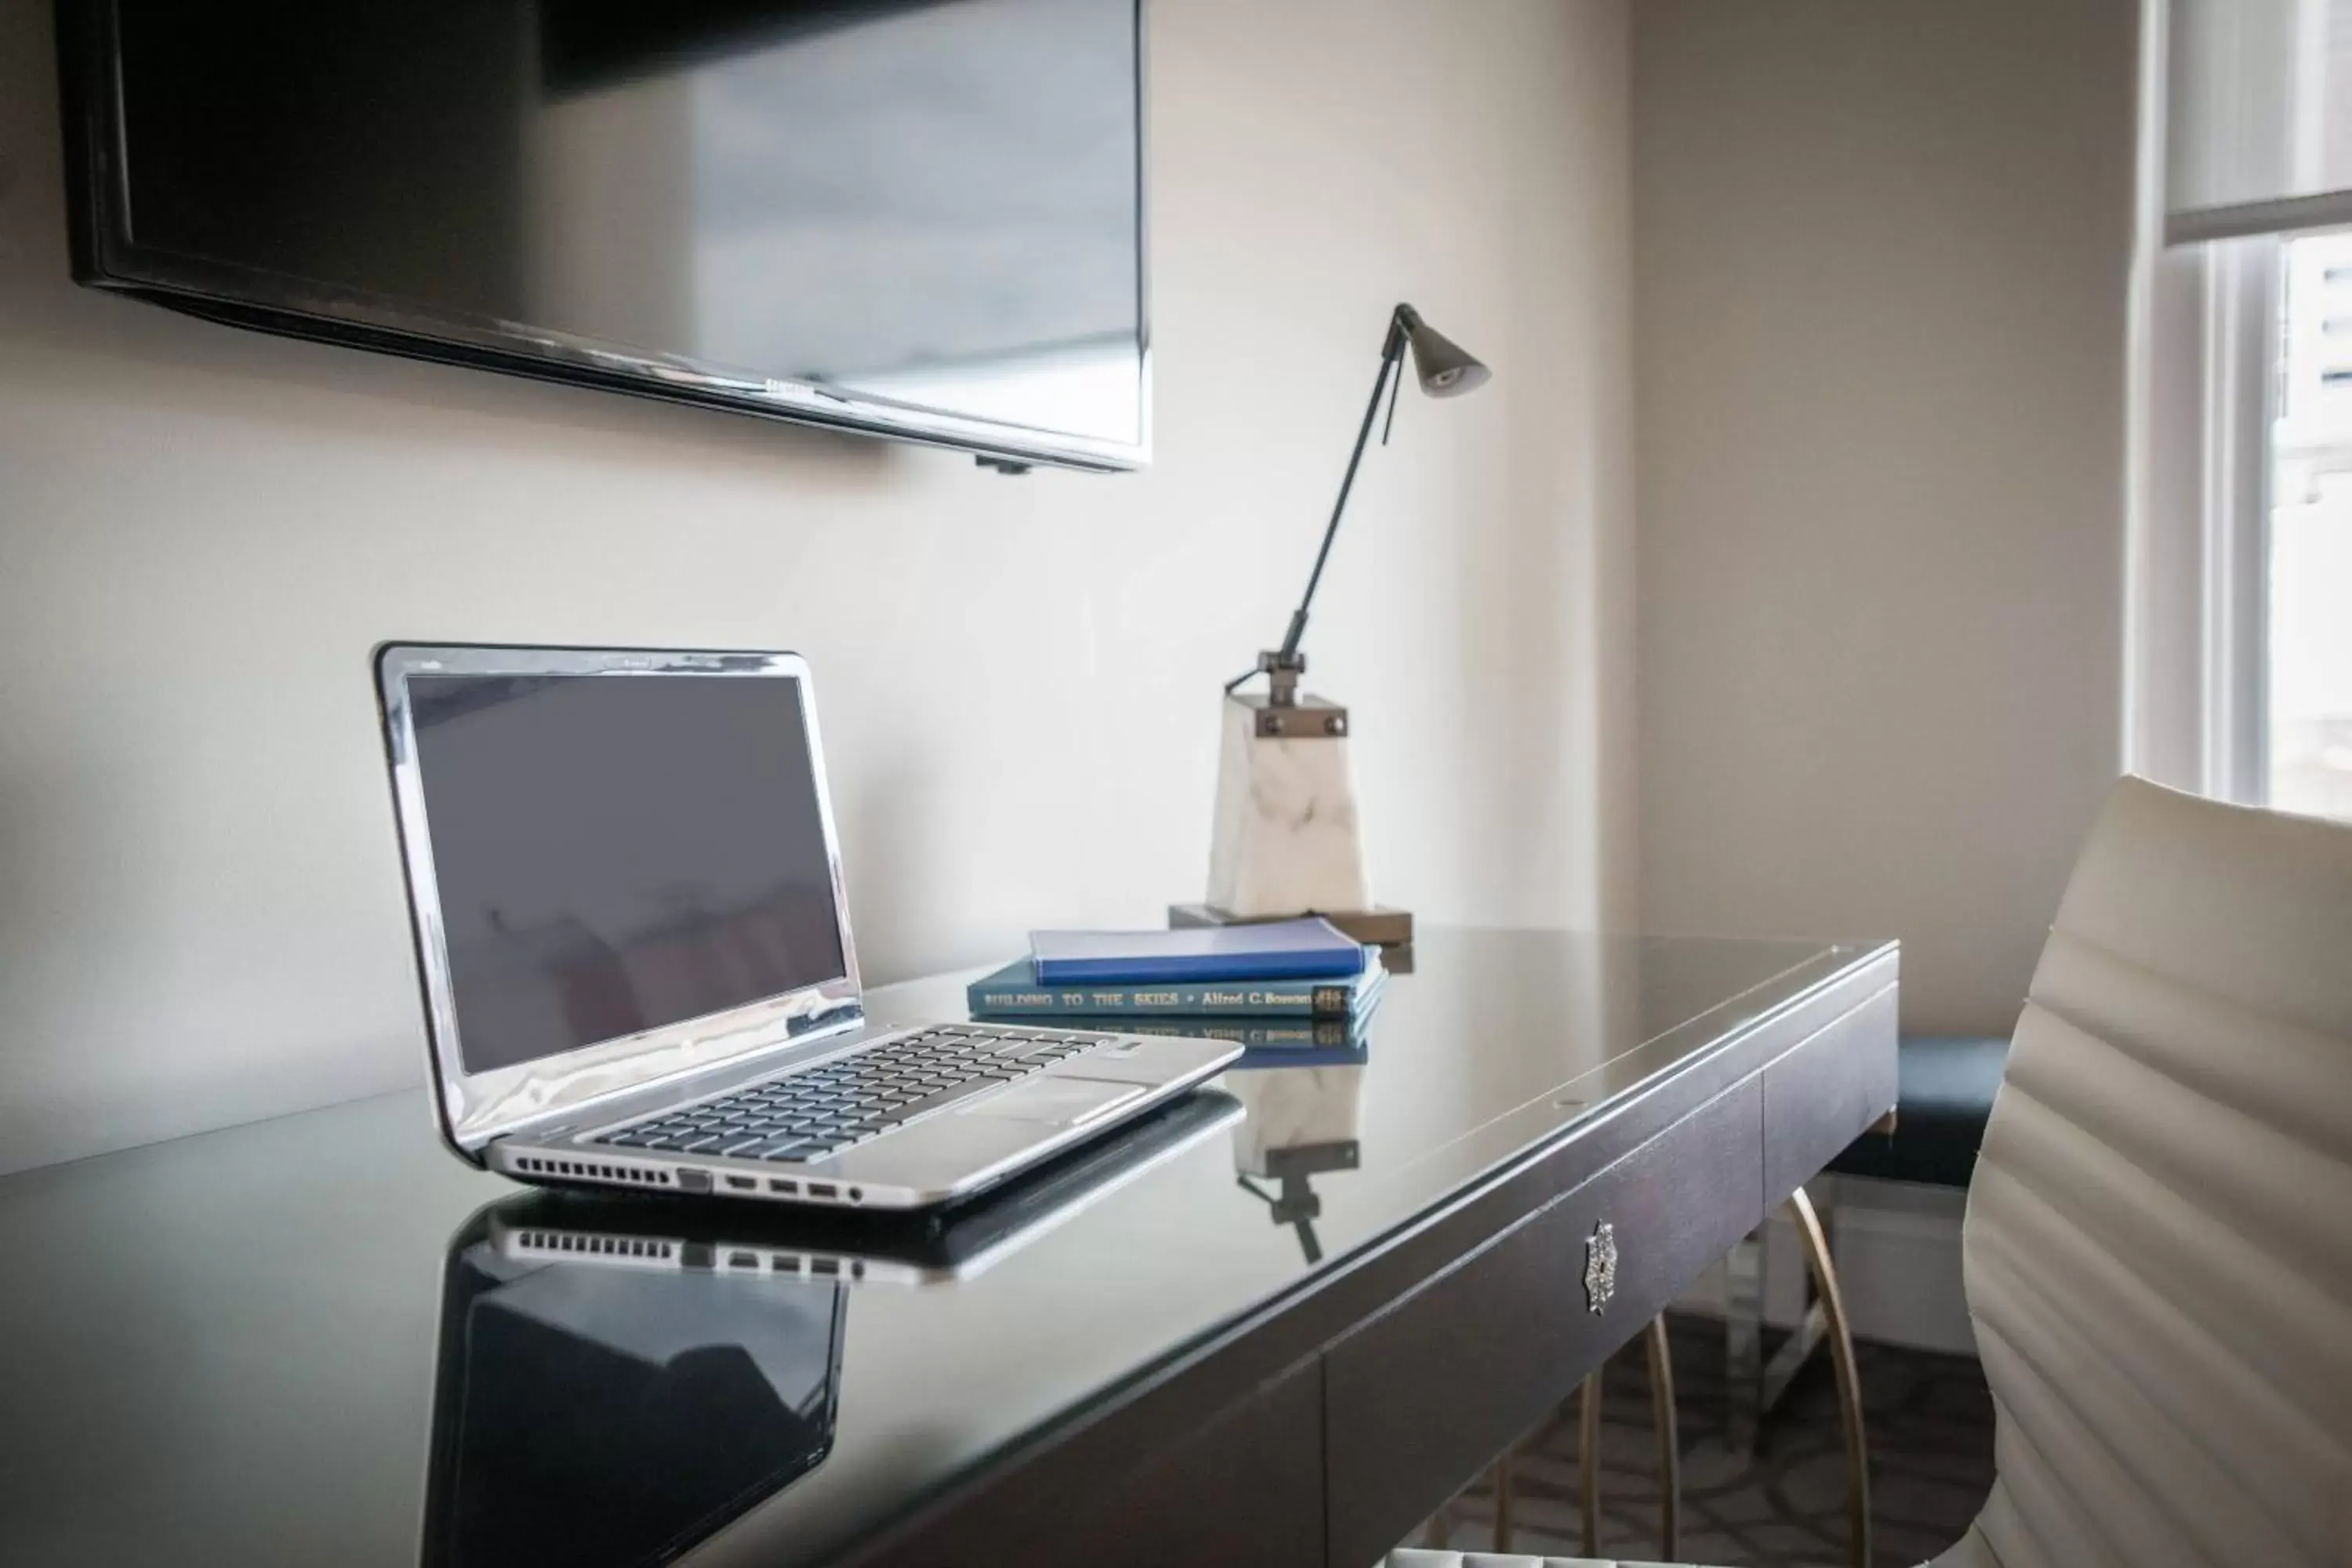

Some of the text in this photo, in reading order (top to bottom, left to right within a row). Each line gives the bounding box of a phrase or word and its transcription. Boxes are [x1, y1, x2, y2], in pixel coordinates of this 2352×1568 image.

[1062, 993, 1083, 1006] TO
[1093, 993, 1123, 1005] THE
[1134, 993, 1179, 1005] SKIES
[1202, 992, 1243, 1005] Alfred
